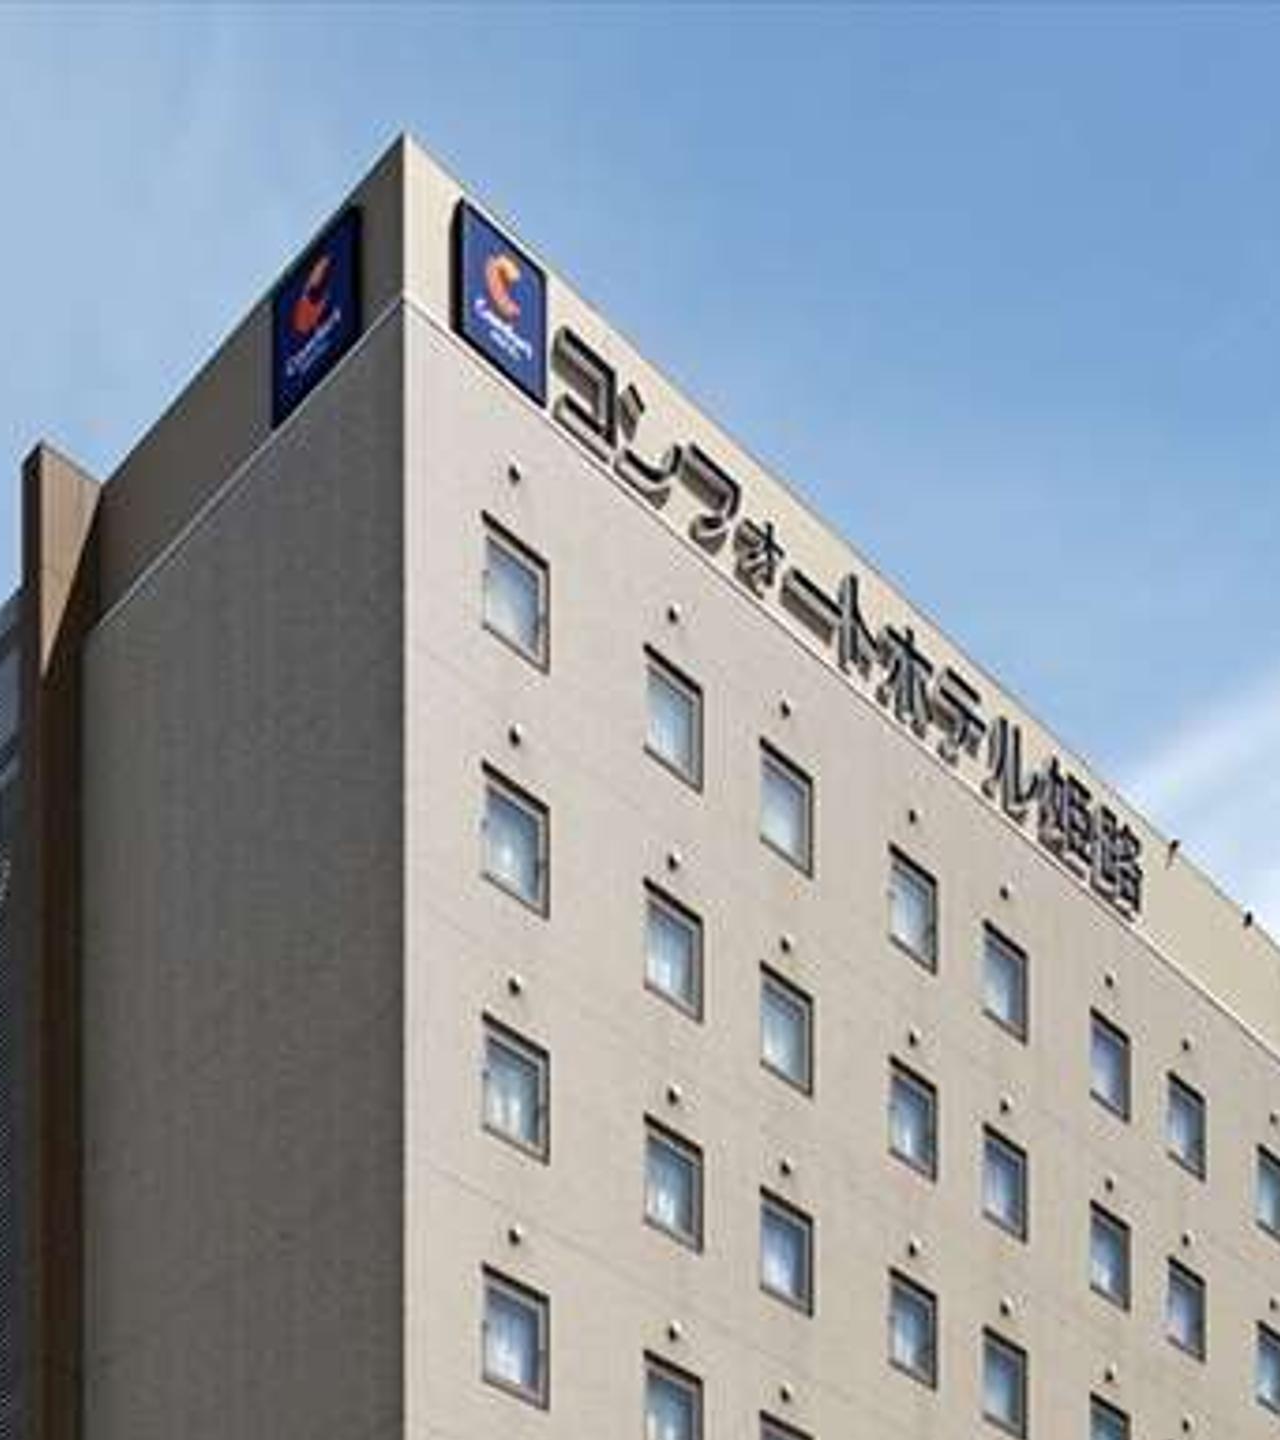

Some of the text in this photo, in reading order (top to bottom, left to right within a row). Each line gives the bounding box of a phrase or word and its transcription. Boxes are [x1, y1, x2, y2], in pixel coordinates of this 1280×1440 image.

[551, 326, 1144, 922] コンフォートホテル姫路
